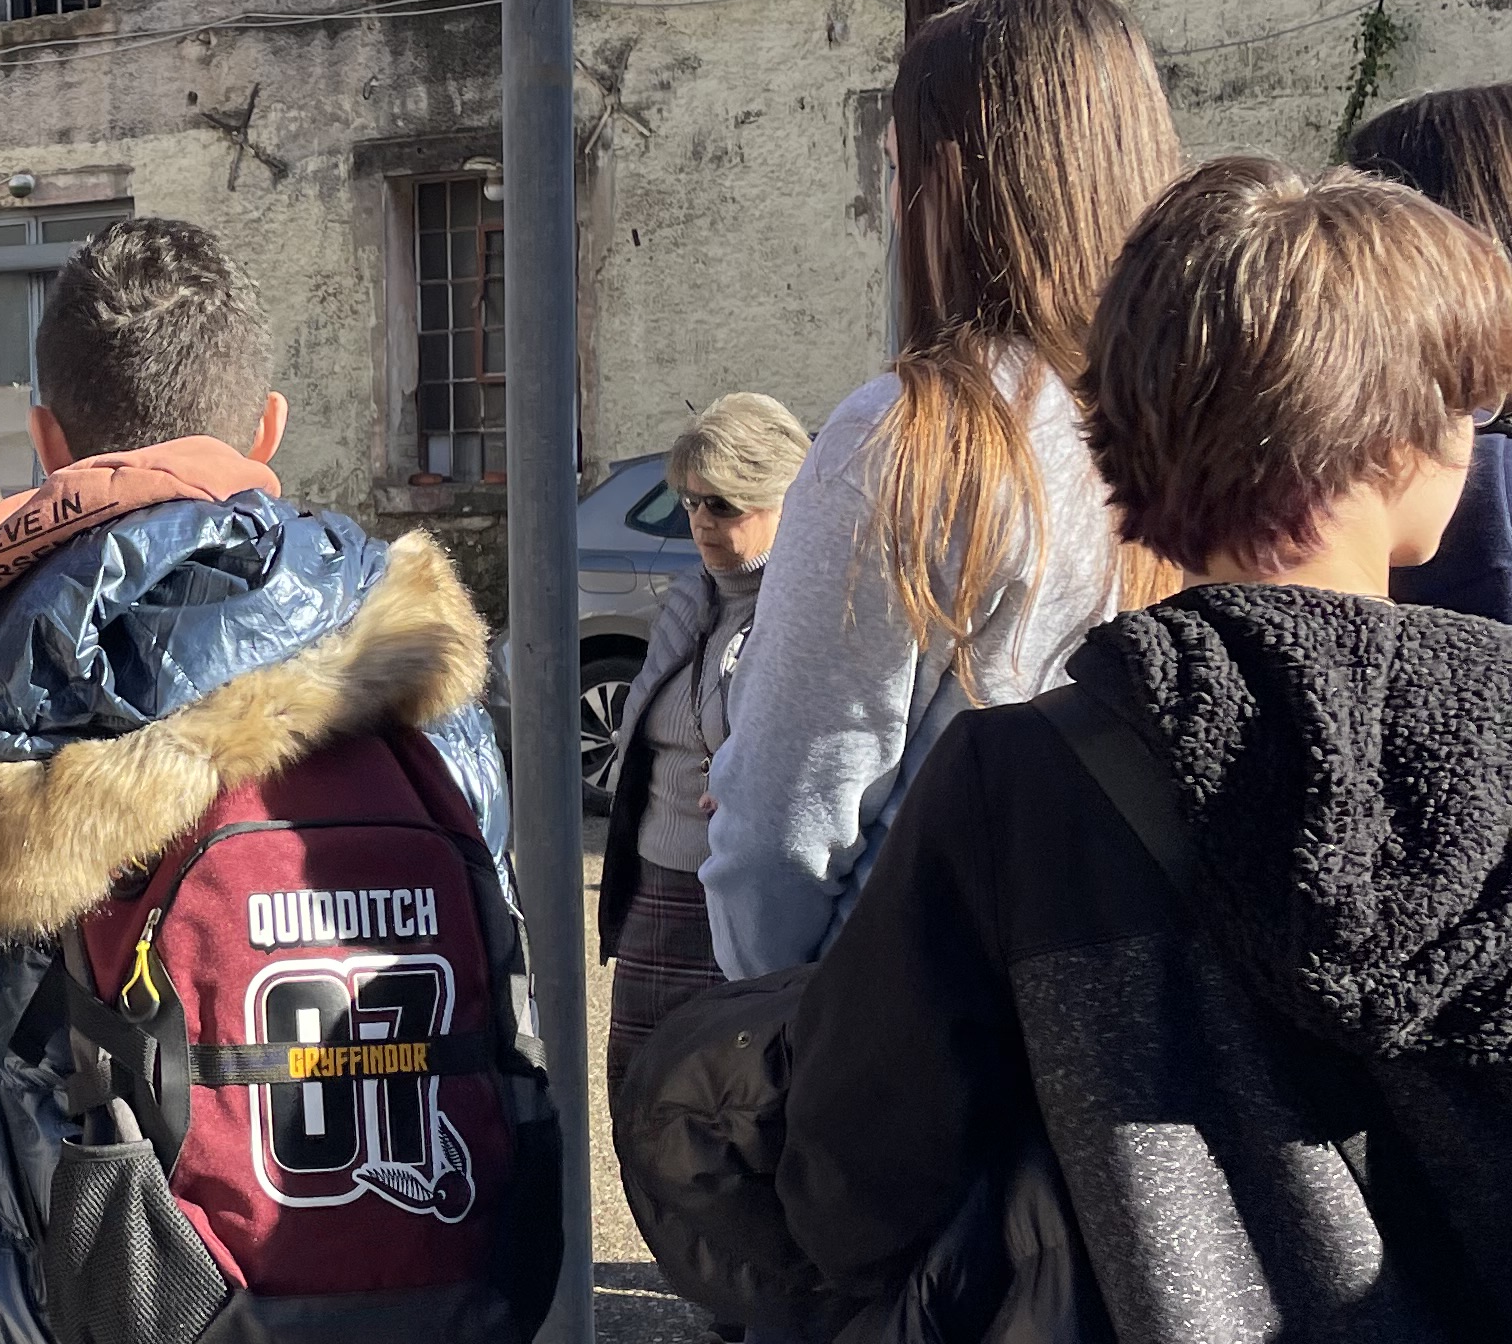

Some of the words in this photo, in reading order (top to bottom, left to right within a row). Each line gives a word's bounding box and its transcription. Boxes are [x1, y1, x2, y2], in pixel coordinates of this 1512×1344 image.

[53, 491, 83, 524] IN
[246, 886, 440, 951] QUIDDITCH
[250, 959, 448, 1194] 07
[288, 1042, 428, 1079] GRYFFINDOR
